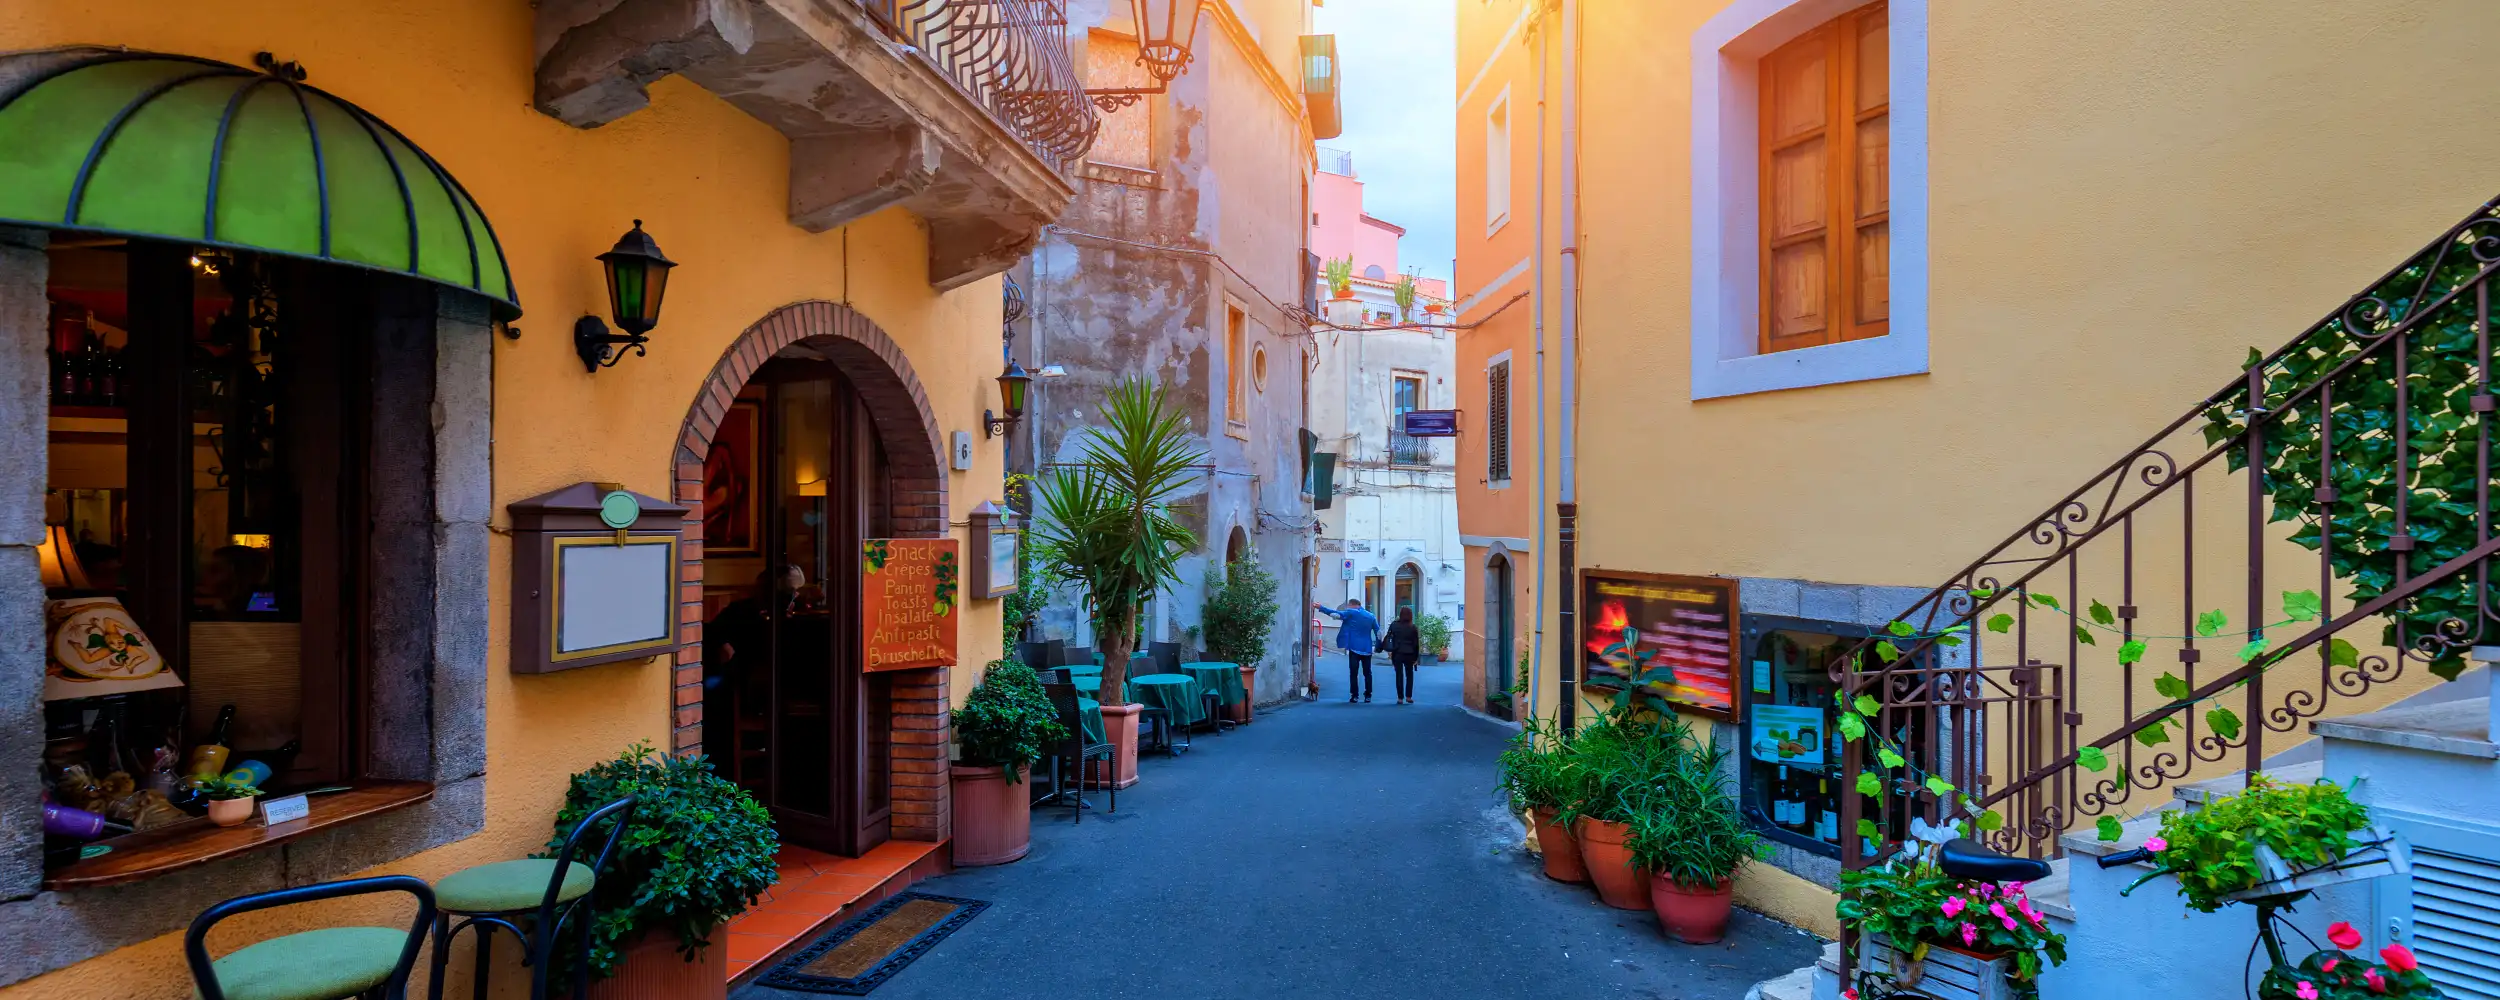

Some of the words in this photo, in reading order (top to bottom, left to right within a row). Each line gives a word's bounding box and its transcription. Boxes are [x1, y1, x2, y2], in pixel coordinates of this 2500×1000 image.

[962, 443, 968, 460] 6
[883, 541, 937, 561] Snack
[884, 562, 931, 581] Crêpes
[885, 579, 927, 595] Panini
[883, 595, 928, 610] Toasts
[878, 608, 934, 626] Insalate
[870, 624, 941, 646] Antipasti
[869, 644, 946, 667] Bruschette
[270, 803, 306, 817] RESERVED
